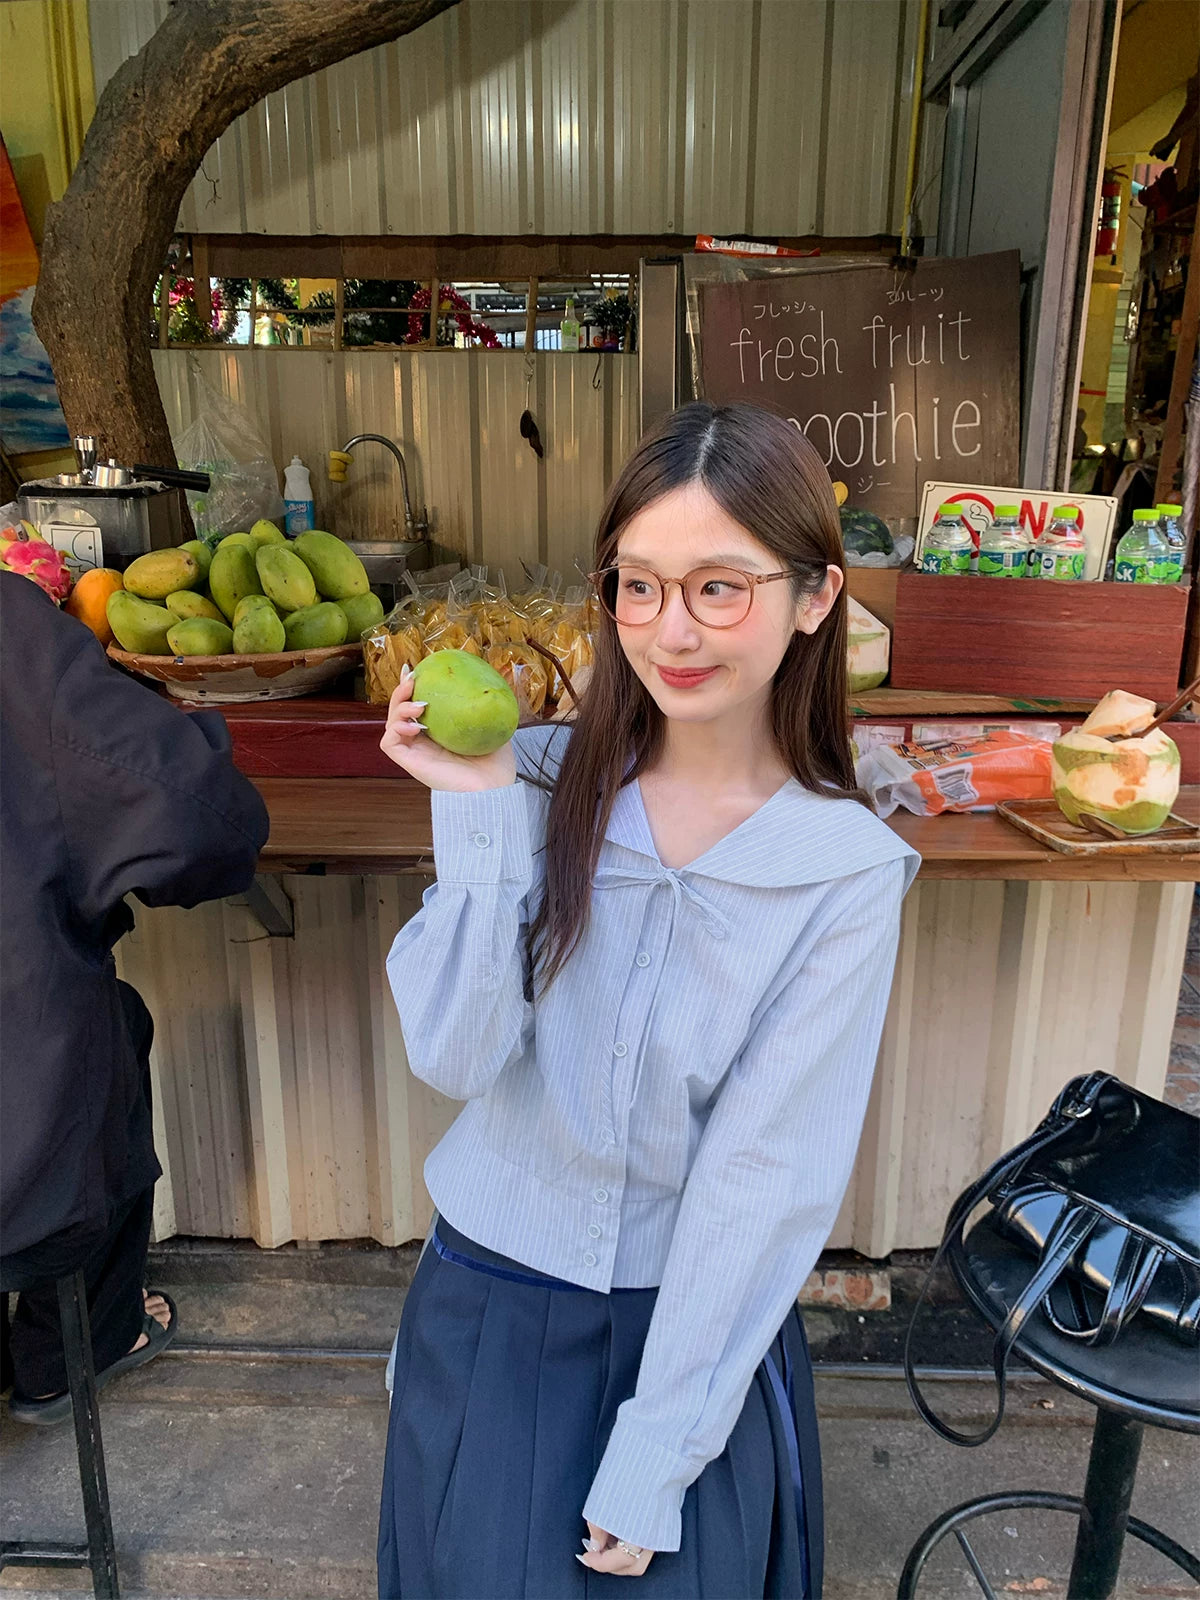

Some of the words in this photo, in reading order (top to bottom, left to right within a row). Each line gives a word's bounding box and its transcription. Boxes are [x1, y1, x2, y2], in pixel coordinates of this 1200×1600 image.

[730, 310, 843, 384] fresh
[862, 311, 972, 369] fruit
[787, 382, 981, 468] oothie
